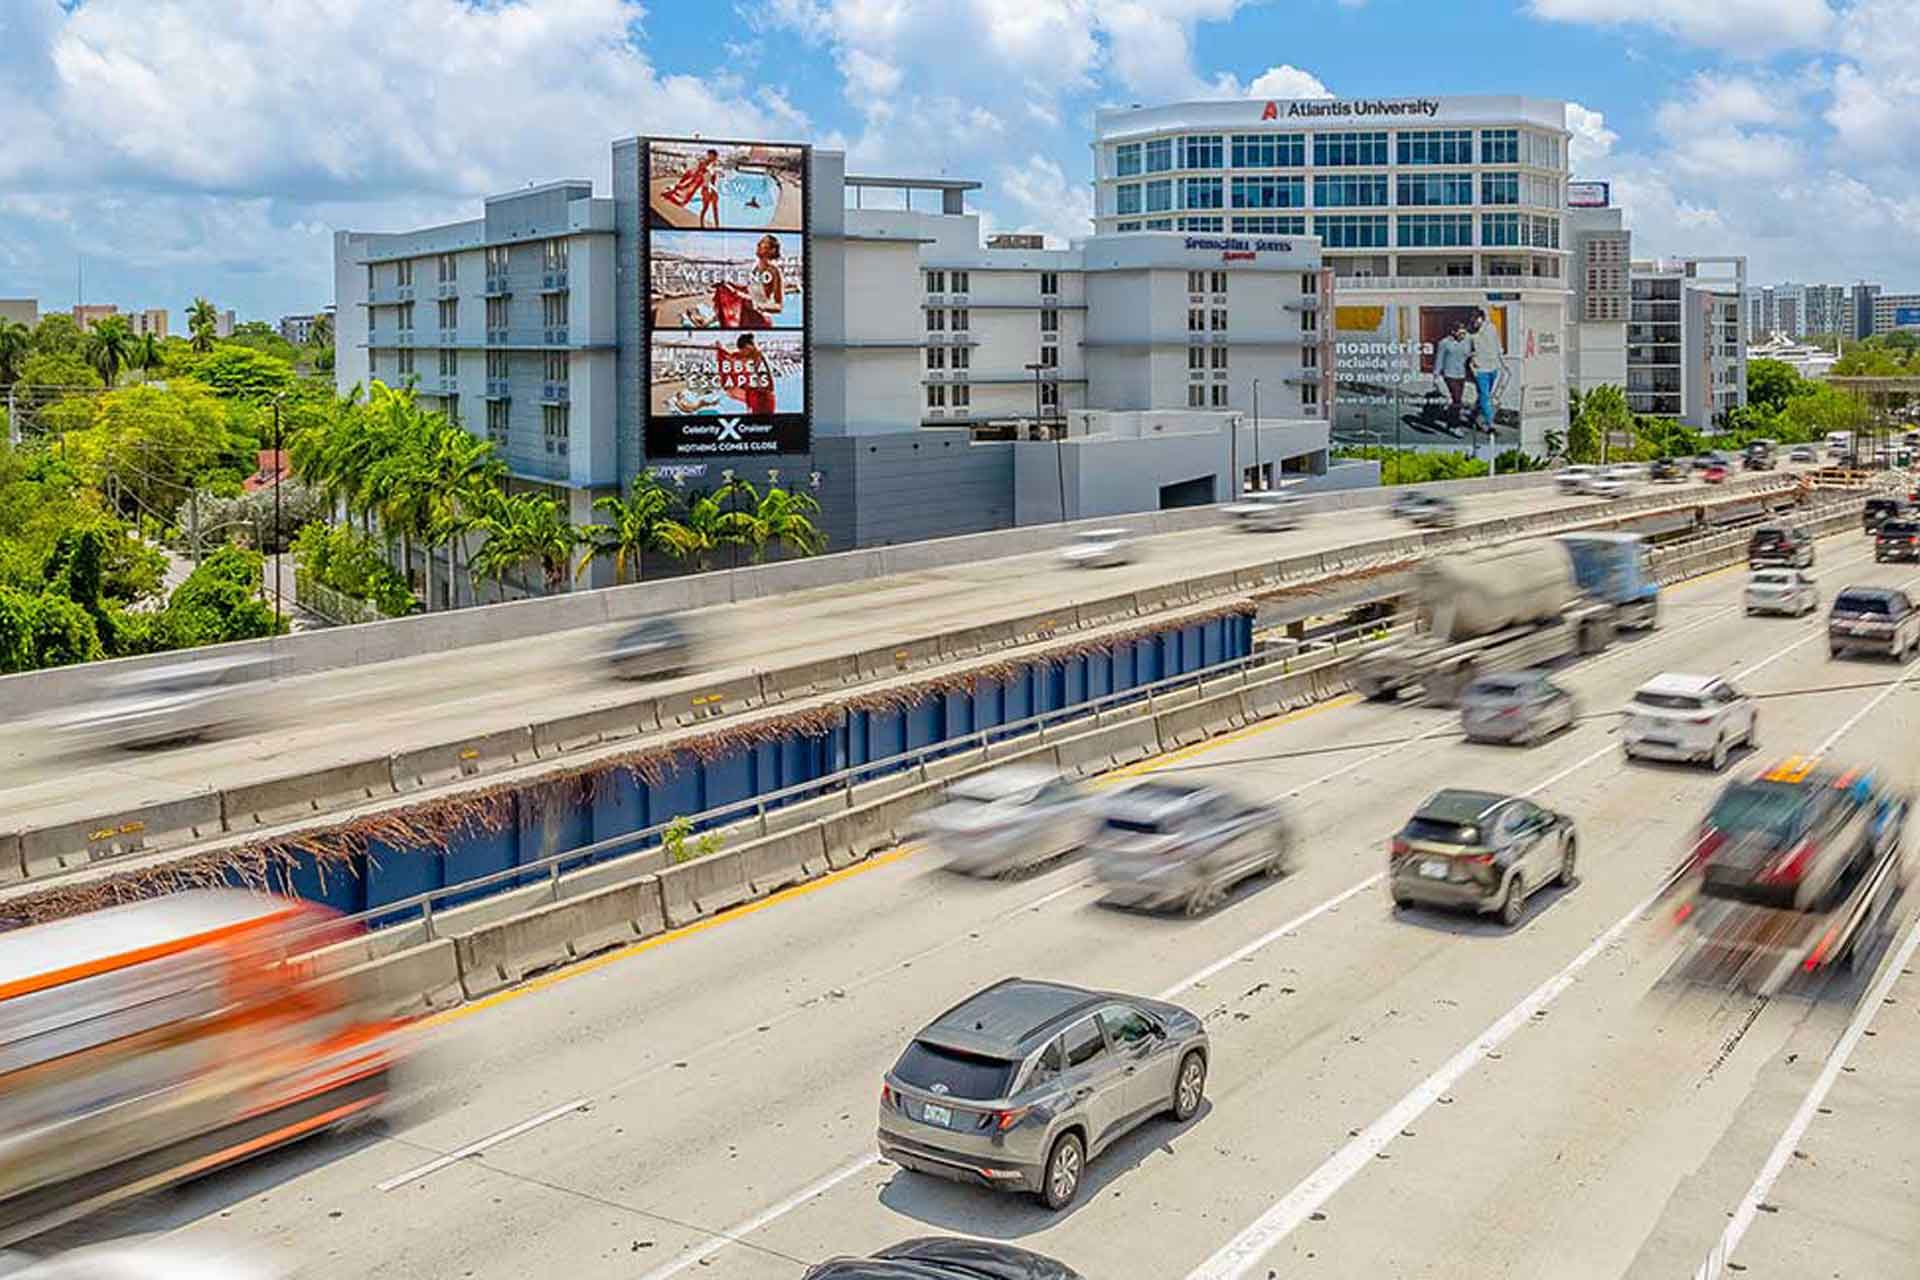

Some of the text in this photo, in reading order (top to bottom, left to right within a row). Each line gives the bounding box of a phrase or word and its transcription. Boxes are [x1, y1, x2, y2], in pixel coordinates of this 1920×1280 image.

[1288, 102, 1350, 117] Atlantis
[1354, 100, 1439, 117] University
[683, 270, 773, 284] WEEKEND
[688, 374, 769, 388] ESCAPES
